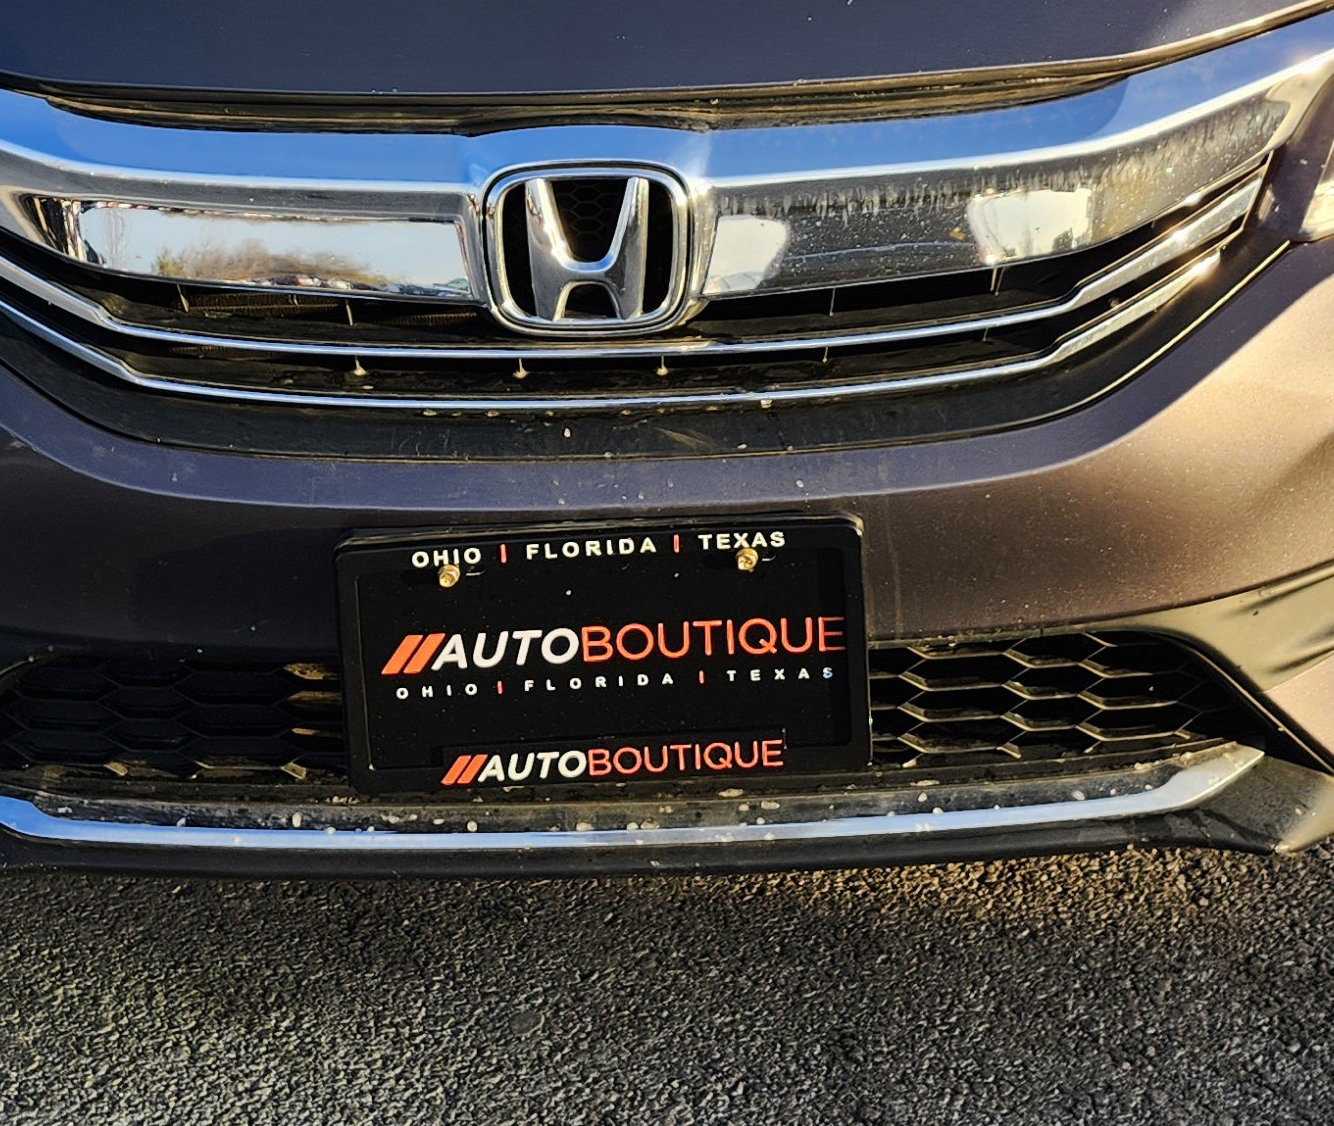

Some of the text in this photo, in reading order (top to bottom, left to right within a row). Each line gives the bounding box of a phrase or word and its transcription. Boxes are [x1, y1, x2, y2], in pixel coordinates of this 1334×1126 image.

[411, 530, 786, 569] OHIO FLORIDA TEXAS
[431, 616, 846, 671] AUTOBOUTIQUE
[396, 666, 834, 700] OHIO FLORIDA TEXAS
[477, 739, 784, 783] AUTOBOUTIQUE
